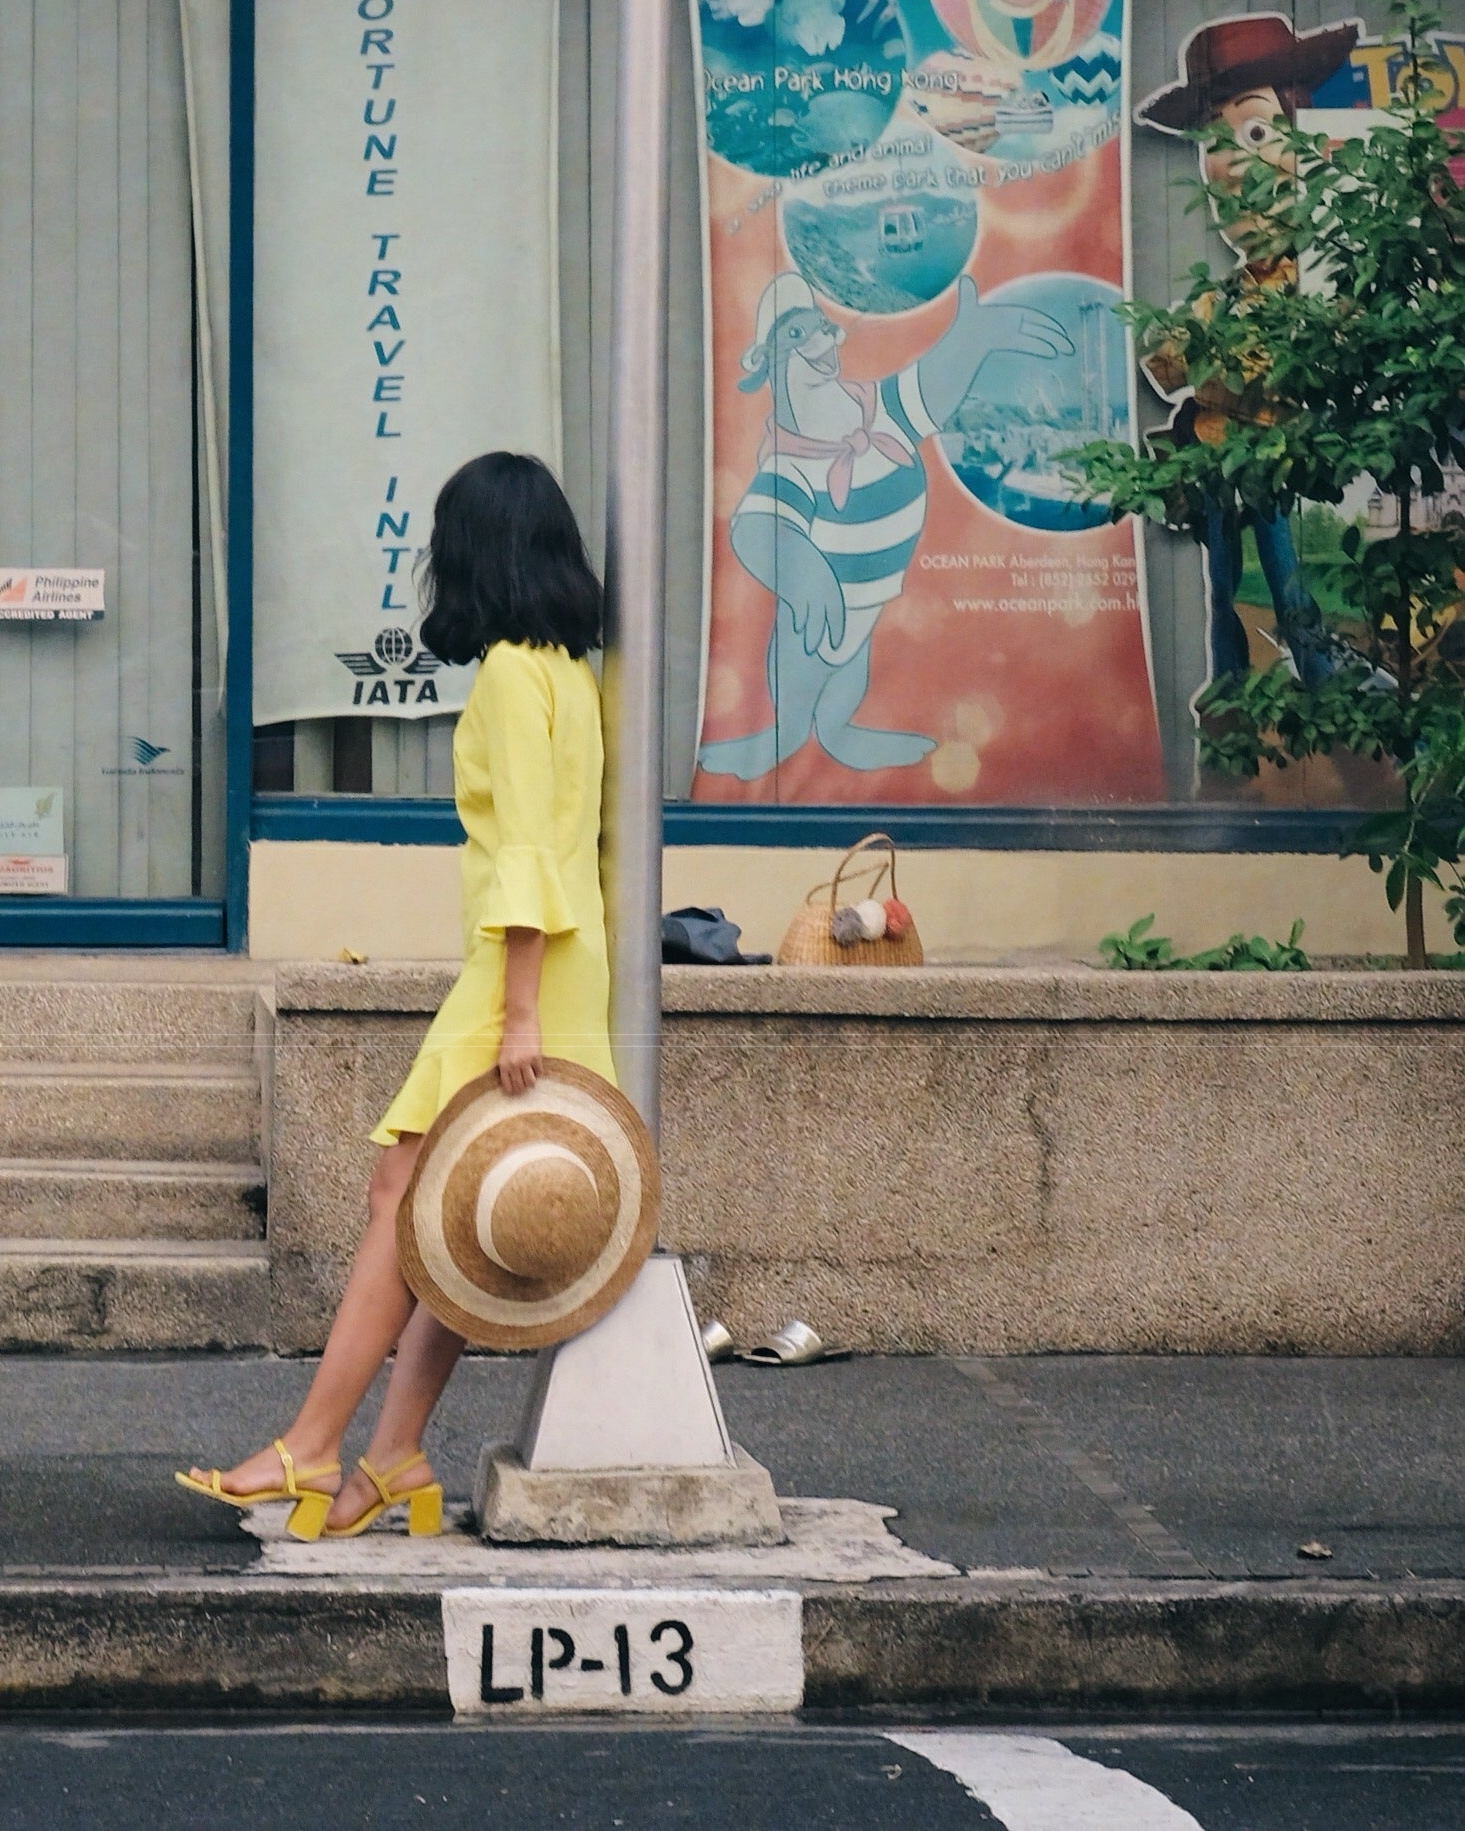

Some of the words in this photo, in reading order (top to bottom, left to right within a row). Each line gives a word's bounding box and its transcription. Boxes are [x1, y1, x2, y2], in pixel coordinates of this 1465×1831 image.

[774, 66, 825, 92] Park
[834, 68, 892, 94] Hong
[828, 144, 868, 168] and
[871, 134, 934, 161] animal
[823, 172, 887, 199] theme
[946, 165, 988, 188] that
[998, 161, 1034, 186] you
[367, 234, 406, 438] TRAVEL
[920, 554, 969, 569] OCEAN
[973, 554, 1006, 569] PARK
[35, 575, 100, 590] Philippine
[32, 590, 82, 603] Airlines
[58, 610, 95, 620] AGENT
[353, 679, 439, 706] IATA
[480, 1619, 695, 1704] LP-13
